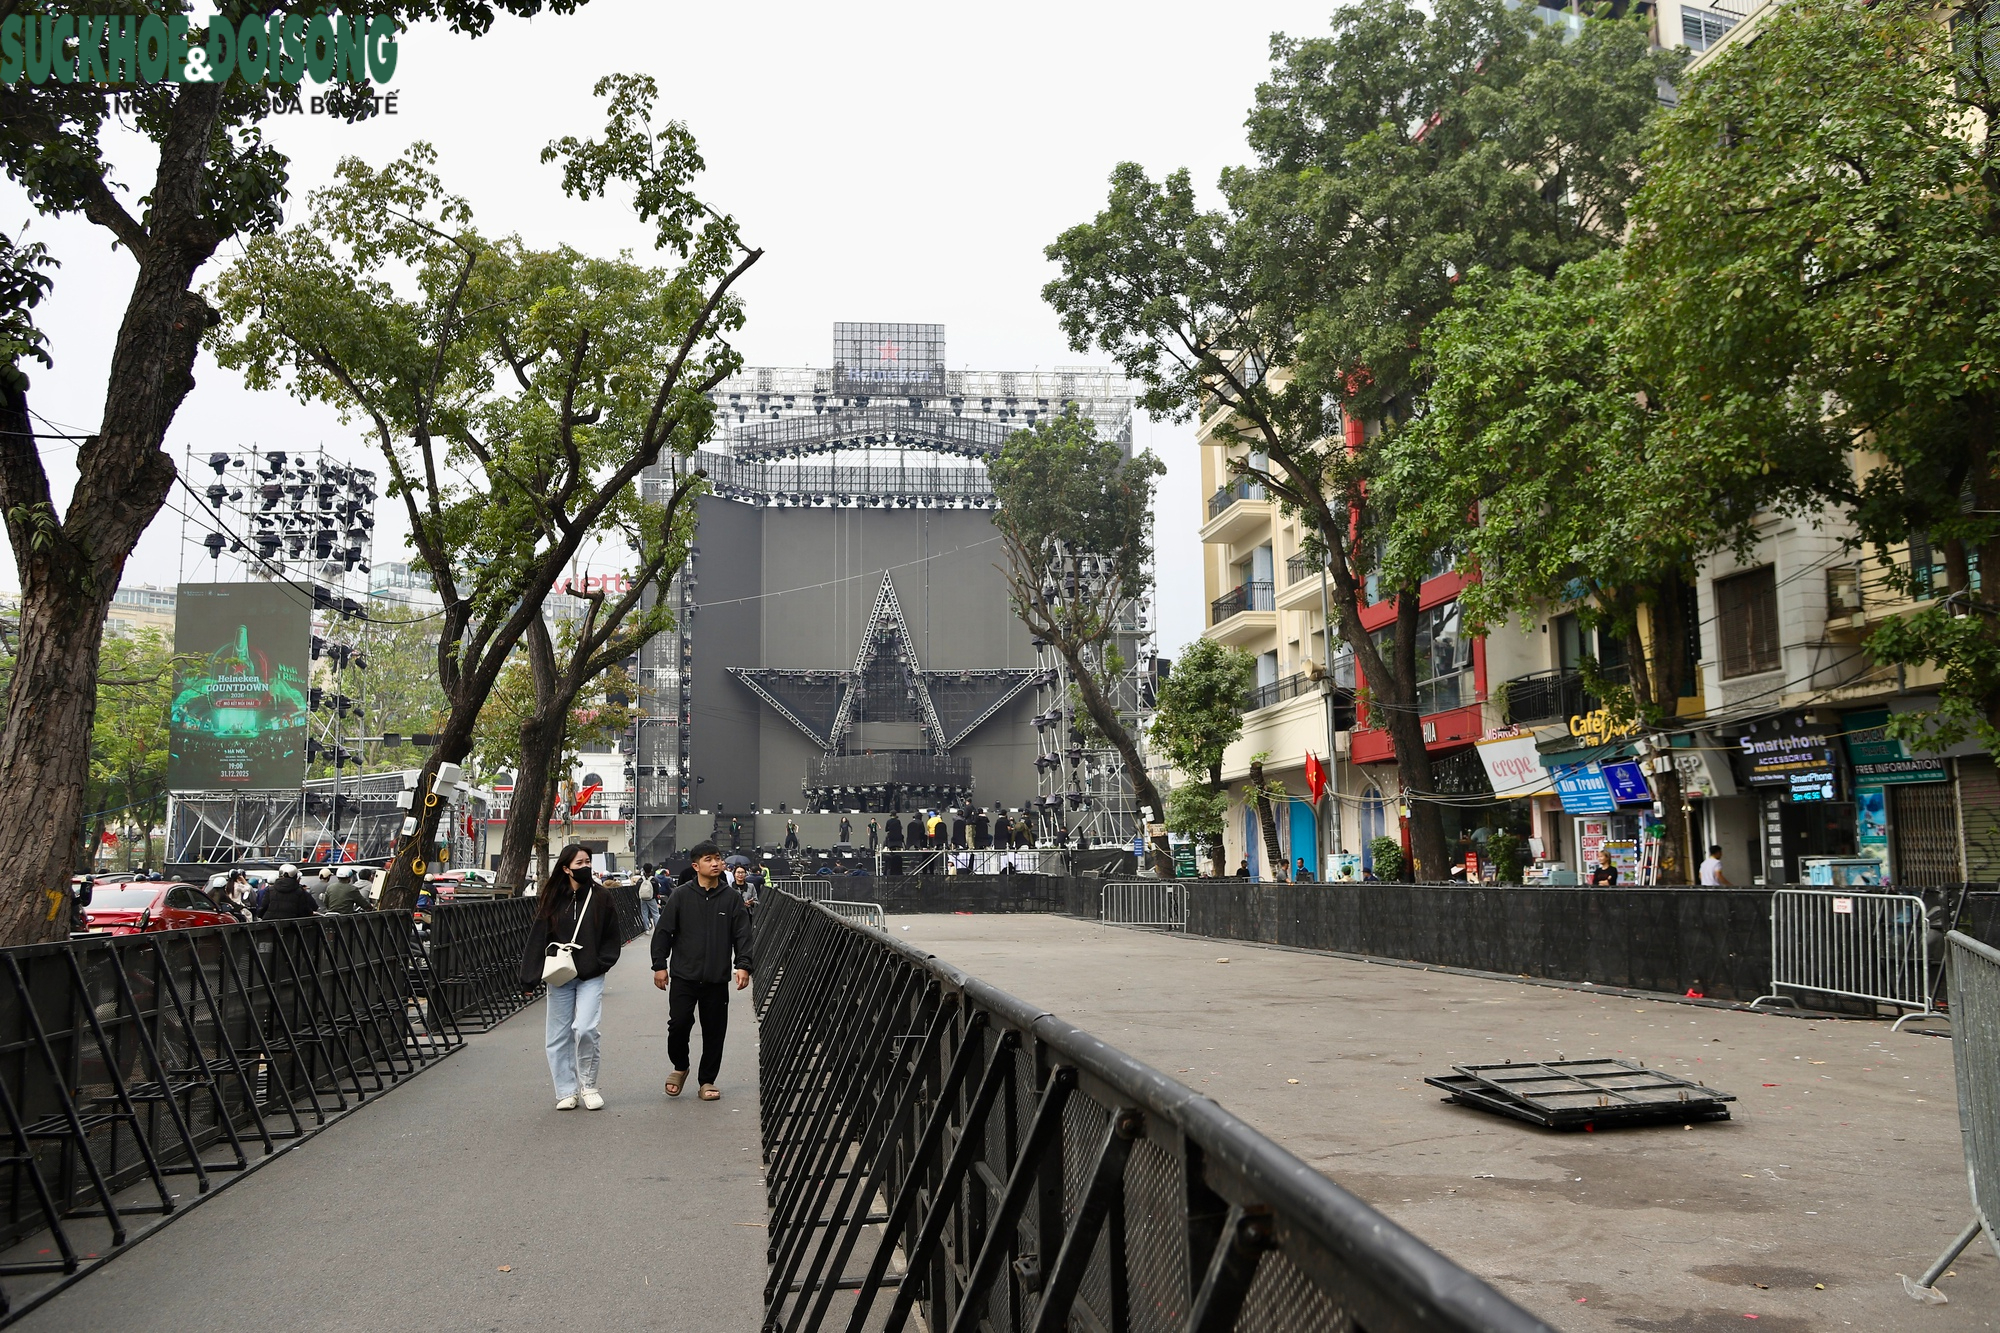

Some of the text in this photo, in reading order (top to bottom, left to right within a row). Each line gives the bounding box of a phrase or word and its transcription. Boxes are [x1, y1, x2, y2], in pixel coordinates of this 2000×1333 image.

[218, 675, 260, 683] Heineken
[206, 683, 269, 692] COUNTDOWN
[1740, 734, 1827, 755] Smartphone
[1860, 745, 1889, 756] TRAVEL
[1758, 753, 1814, 765] ACCESSORIES
[228, 762, 244, 770] 19:00
[1854, 760, 1941, 774] FREE INFORMATION
[1560, 779, 1578, 792] Kim
[1576, 775, 1605, 791] Travel
[1790, 772, 1833, 784] SmartPhone
